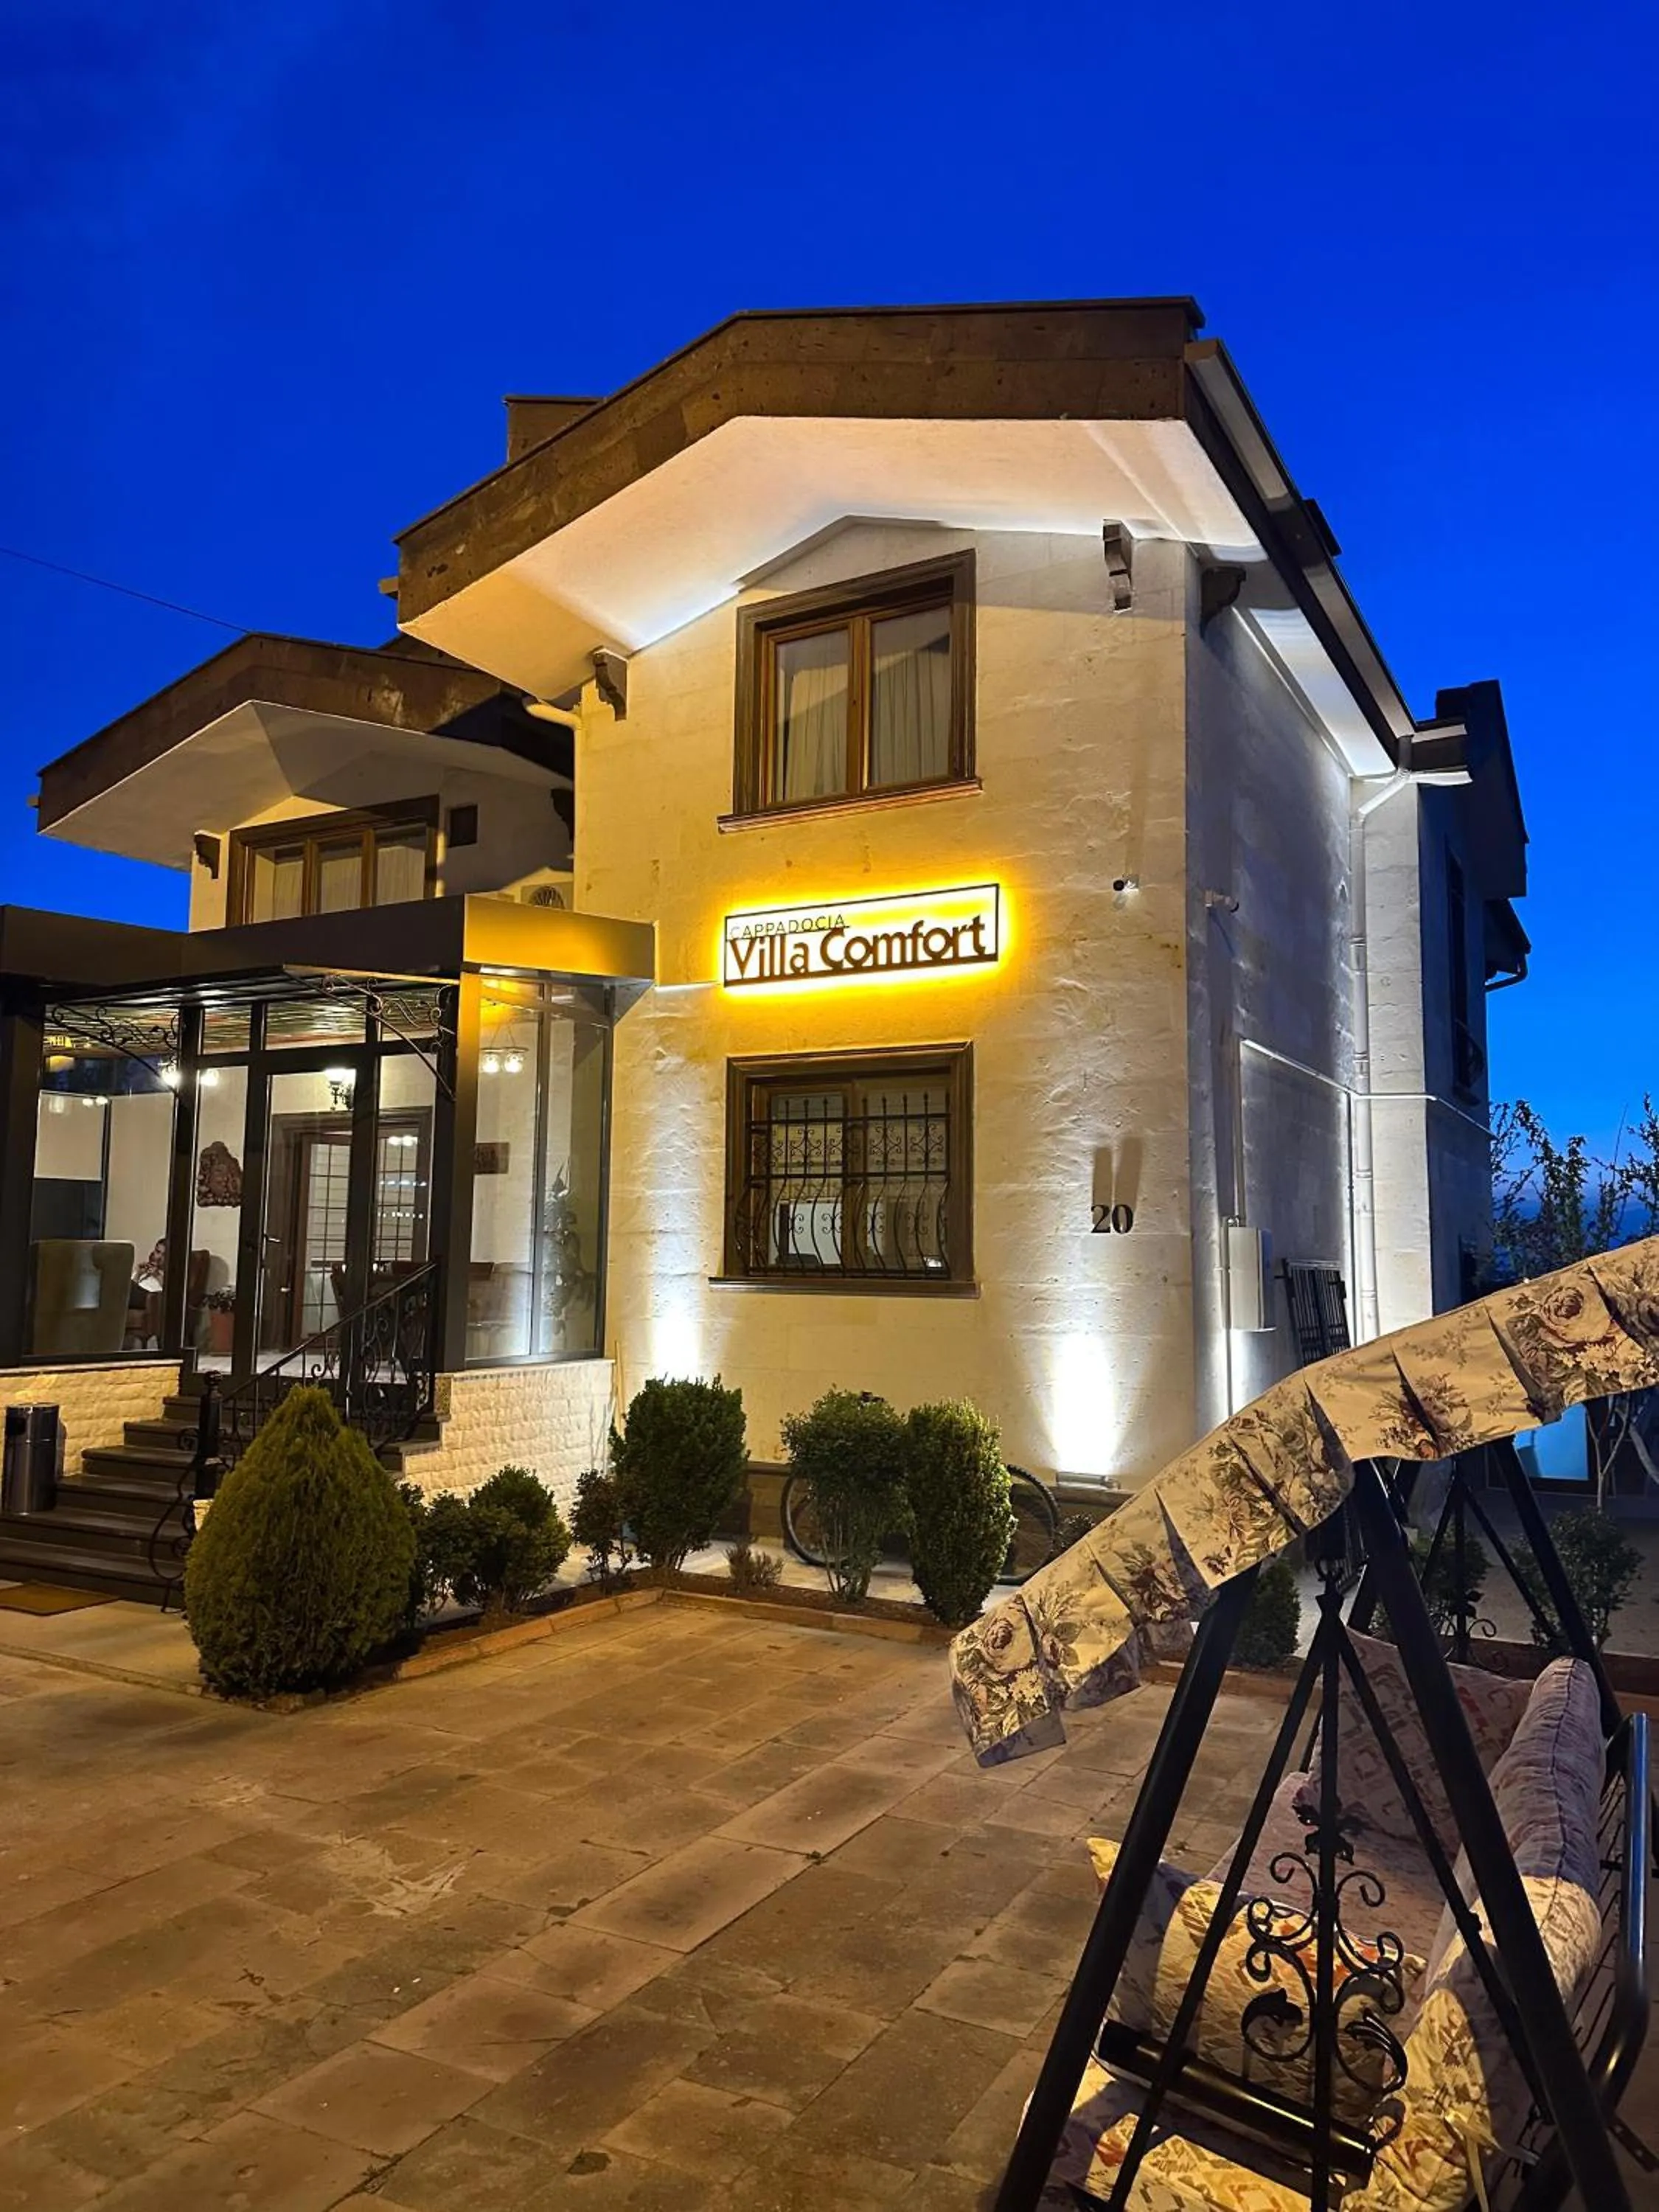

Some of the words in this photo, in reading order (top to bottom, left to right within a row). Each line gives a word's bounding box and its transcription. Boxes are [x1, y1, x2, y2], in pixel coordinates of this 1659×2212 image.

[730, 914, 846, 940] CAPPADOCIA
[729, 933, 810, 980] Villa
[819, 914, 985, 971] Comfort
[1091, 1204, 1133, 1234] 20
